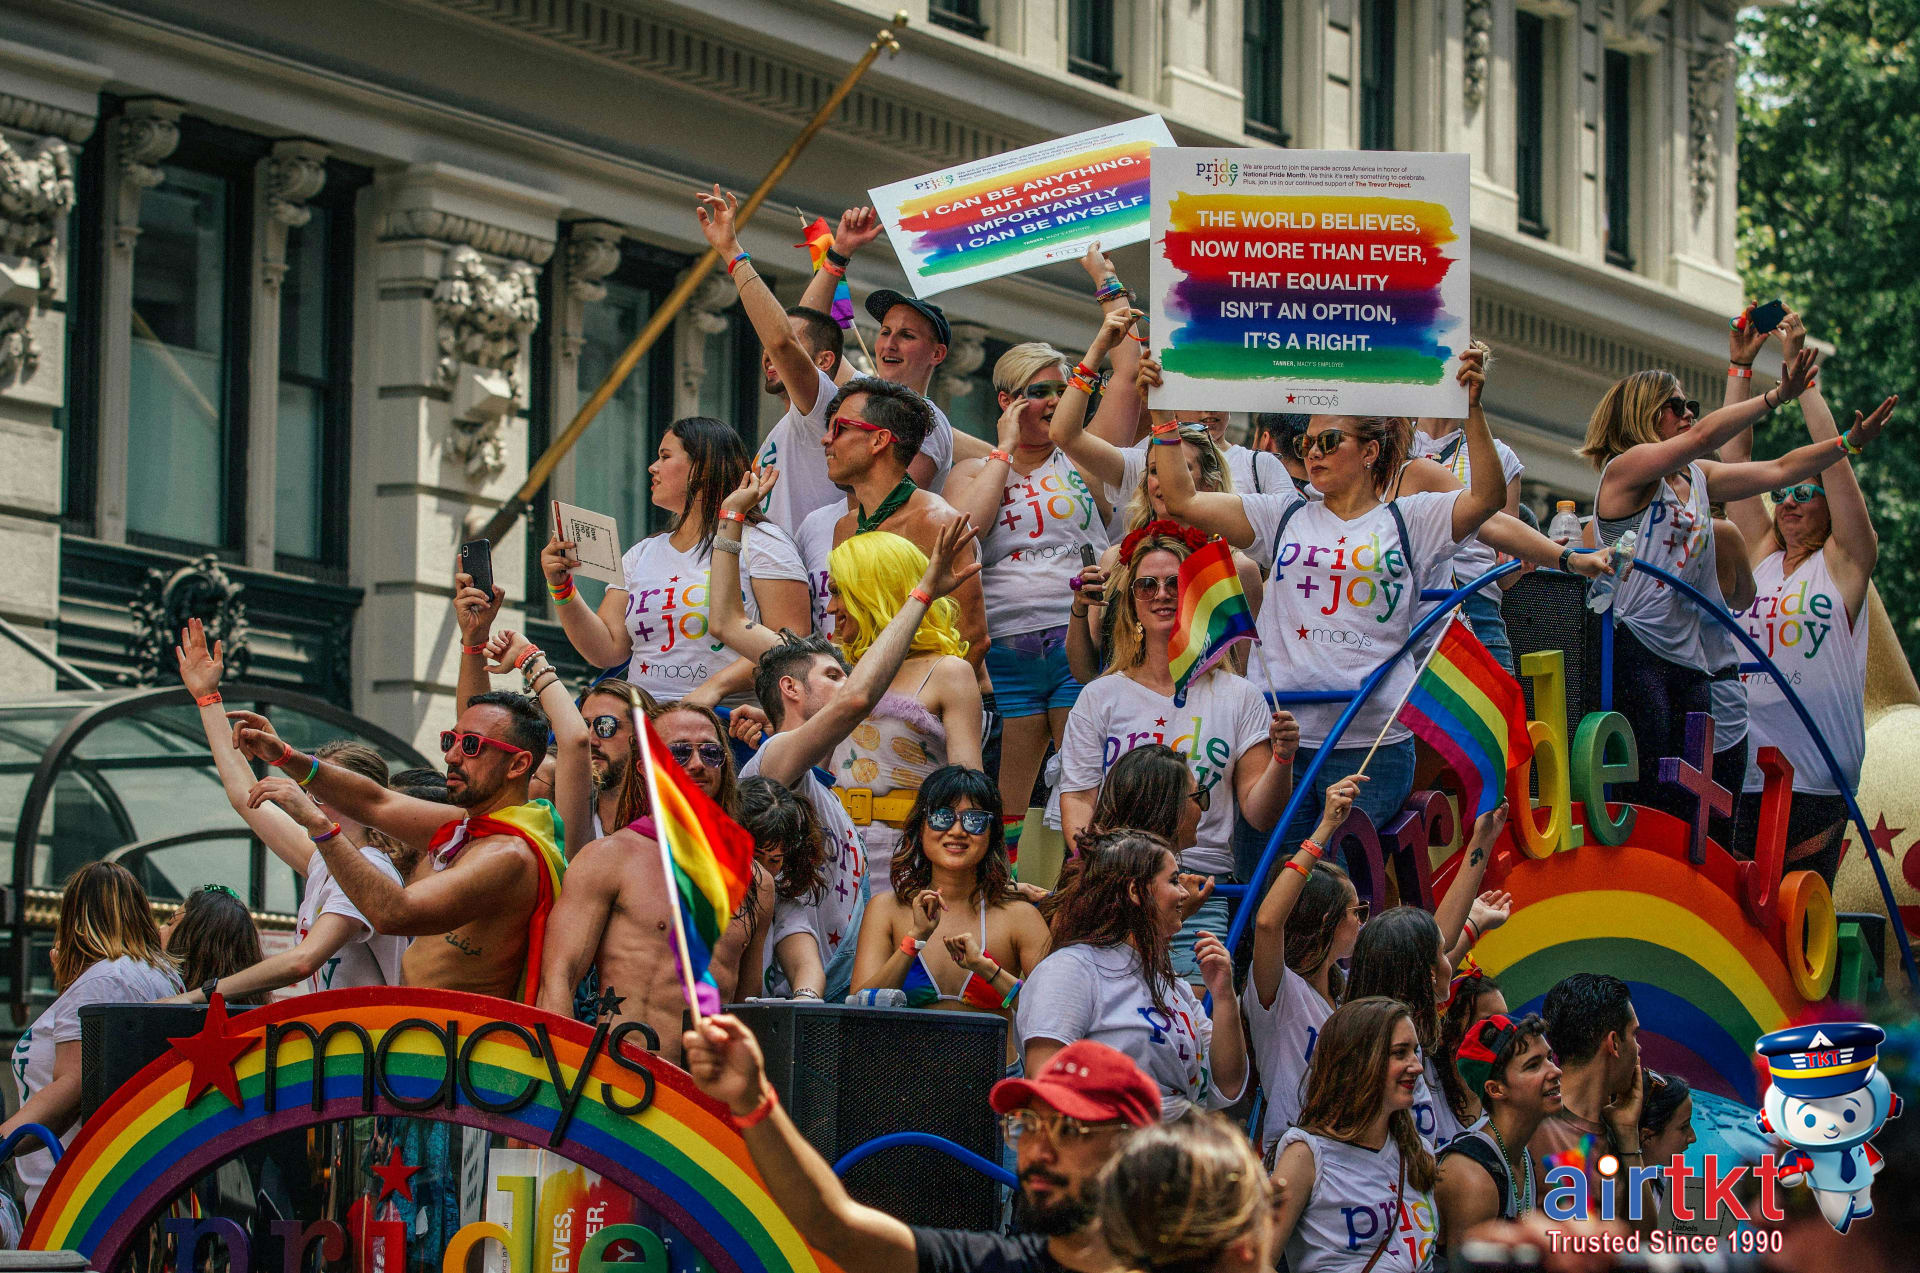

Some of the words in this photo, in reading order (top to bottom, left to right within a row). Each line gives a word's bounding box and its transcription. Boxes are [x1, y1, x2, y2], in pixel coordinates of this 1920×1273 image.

[1196, 158, 1238, 176] pride
[1264, 163, 1280, 172] proud
[922, 210, 930, 219] I
[935, 197, 983, 217] CAN
[987, 186, 1017, 202] BE
[1022, 156, 1141, 192] ANYTHING,
[1205, 173, 1238, 187] +joy
[1324, 180, 1347, 188] support
[968, 187, 1119, 235] IMPORTANTLY
[980, 197, 1025, 217] BUT
[1031, 180, 1094, 205] MOST
[955, 243, 964, 252] I
[968, 229, 1016, 249] CAN
[1020, 219, 1052, 235] BE
[1057, 195, 1145, 226] MYSELF
[1197, 210, 1236, 228] THE
[1241, 211, 1316, 229] WORLD
[1321, 212, 1421, 235] BELIEVES,
[1191, 240, 1239, 258] NOW
[1244, 241, 1305, 259] MORE
[1309, 242, 1364, 260] THAN
[1370, 244, 1427, 265] EVER,
[1228, 271, 1281, 289] THAT
[1286, 272, 1389, 292] EQUALITY
[1220, 301, 1272, 319] ISN'T
[1277, 302, 1306, 320] AN
[1312, 303, 1397, 326] OPTION,
[1244, 331, 1281, 349] IT'S
[1285, 333, 1300, 350] A
[1306, 333, 1373, 351] RIGHT.
[1297, 393, 1339, 409] macy's
[1001, 464, 1089, 507] ride
[1025, 540, 1080, 561] macy's
[1276, 532, 1404, 582] pride
[1296, 575, 1404, 624] +joy
[1732, 580, 1833, 619] ride
[1312, 627, 1373, 649] macy's
[650, 663, 709, 681] macy's
[264, 990, 662, 1148] macy's
